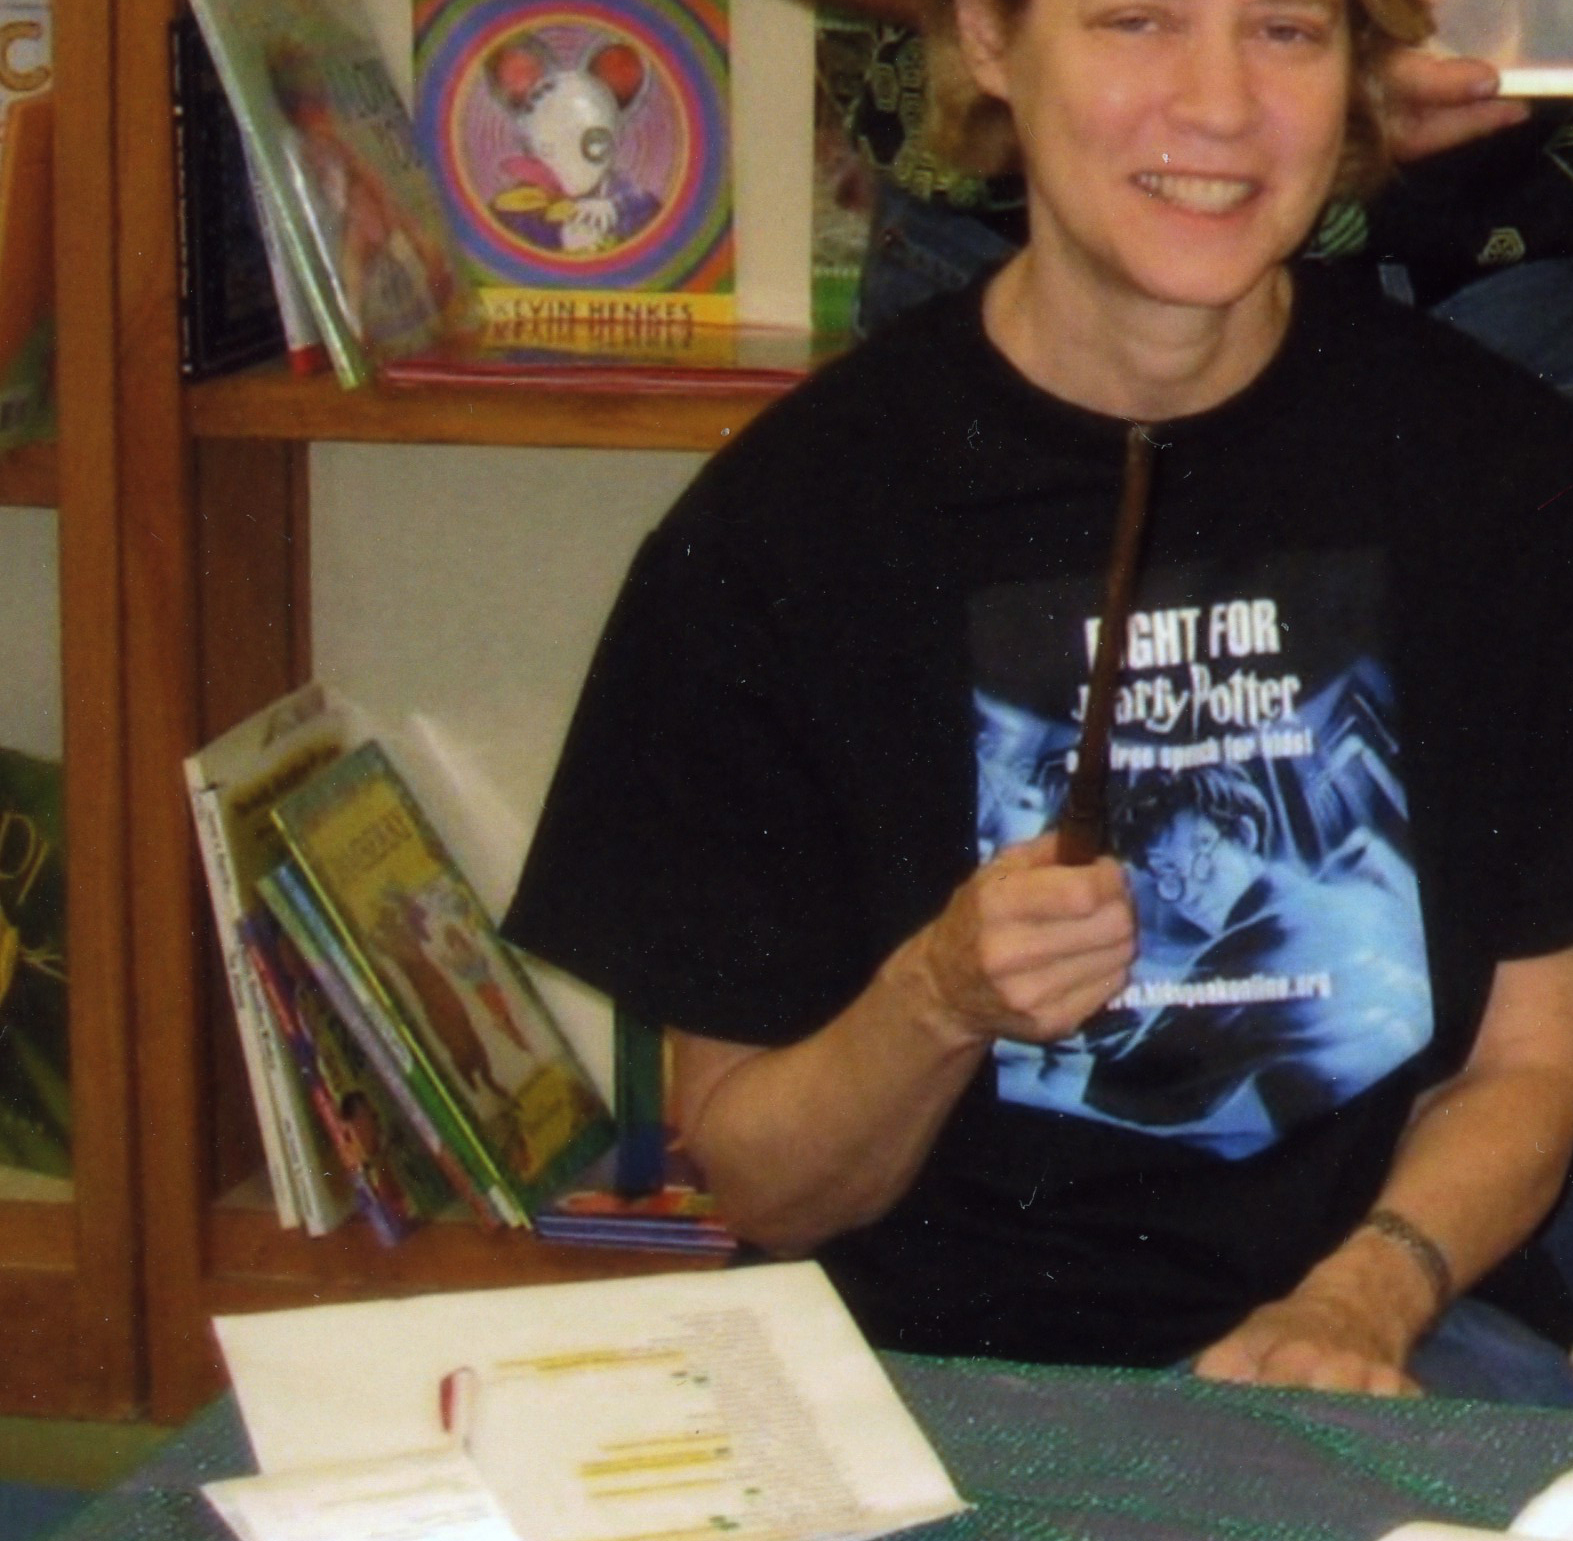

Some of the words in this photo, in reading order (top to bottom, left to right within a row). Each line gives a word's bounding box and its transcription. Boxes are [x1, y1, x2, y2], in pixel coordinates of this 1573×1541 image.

[588, 301, 694, 326] HENKES
[1209, 599, 1281, 659] FOR
[1189, 662, 1303, 740] Potter
[1223, 734, 1257, 764] for
